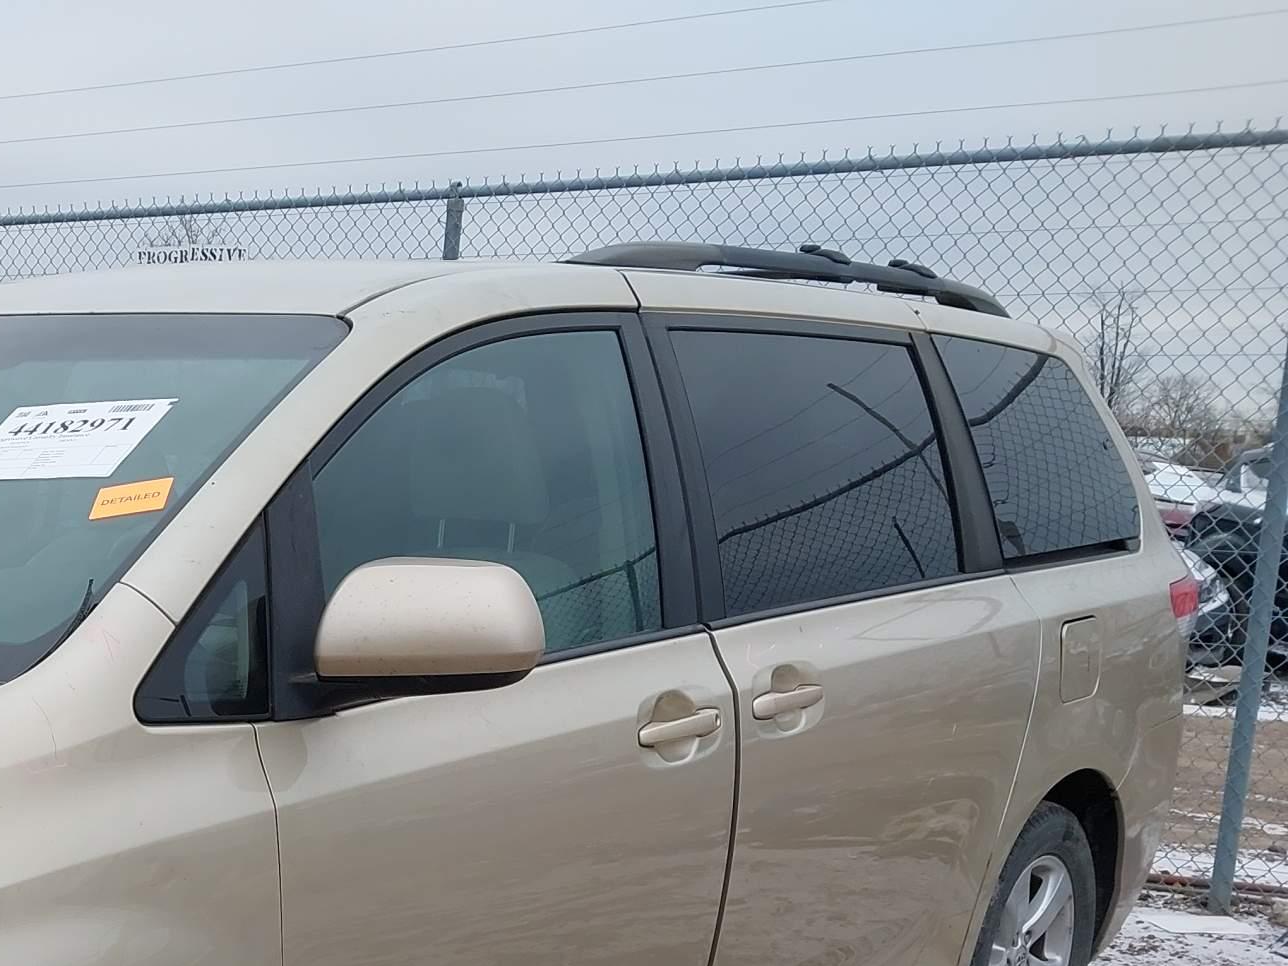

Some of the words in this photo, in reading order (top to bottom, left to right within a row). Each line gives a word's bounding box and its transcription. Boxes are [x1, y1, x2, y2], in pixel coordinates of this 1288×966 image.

[137, 247, 247, 265] PROGRESSIVE
[8, 416, 136, 437] 44182971
[100, 491, 161, 506] DETAILED
